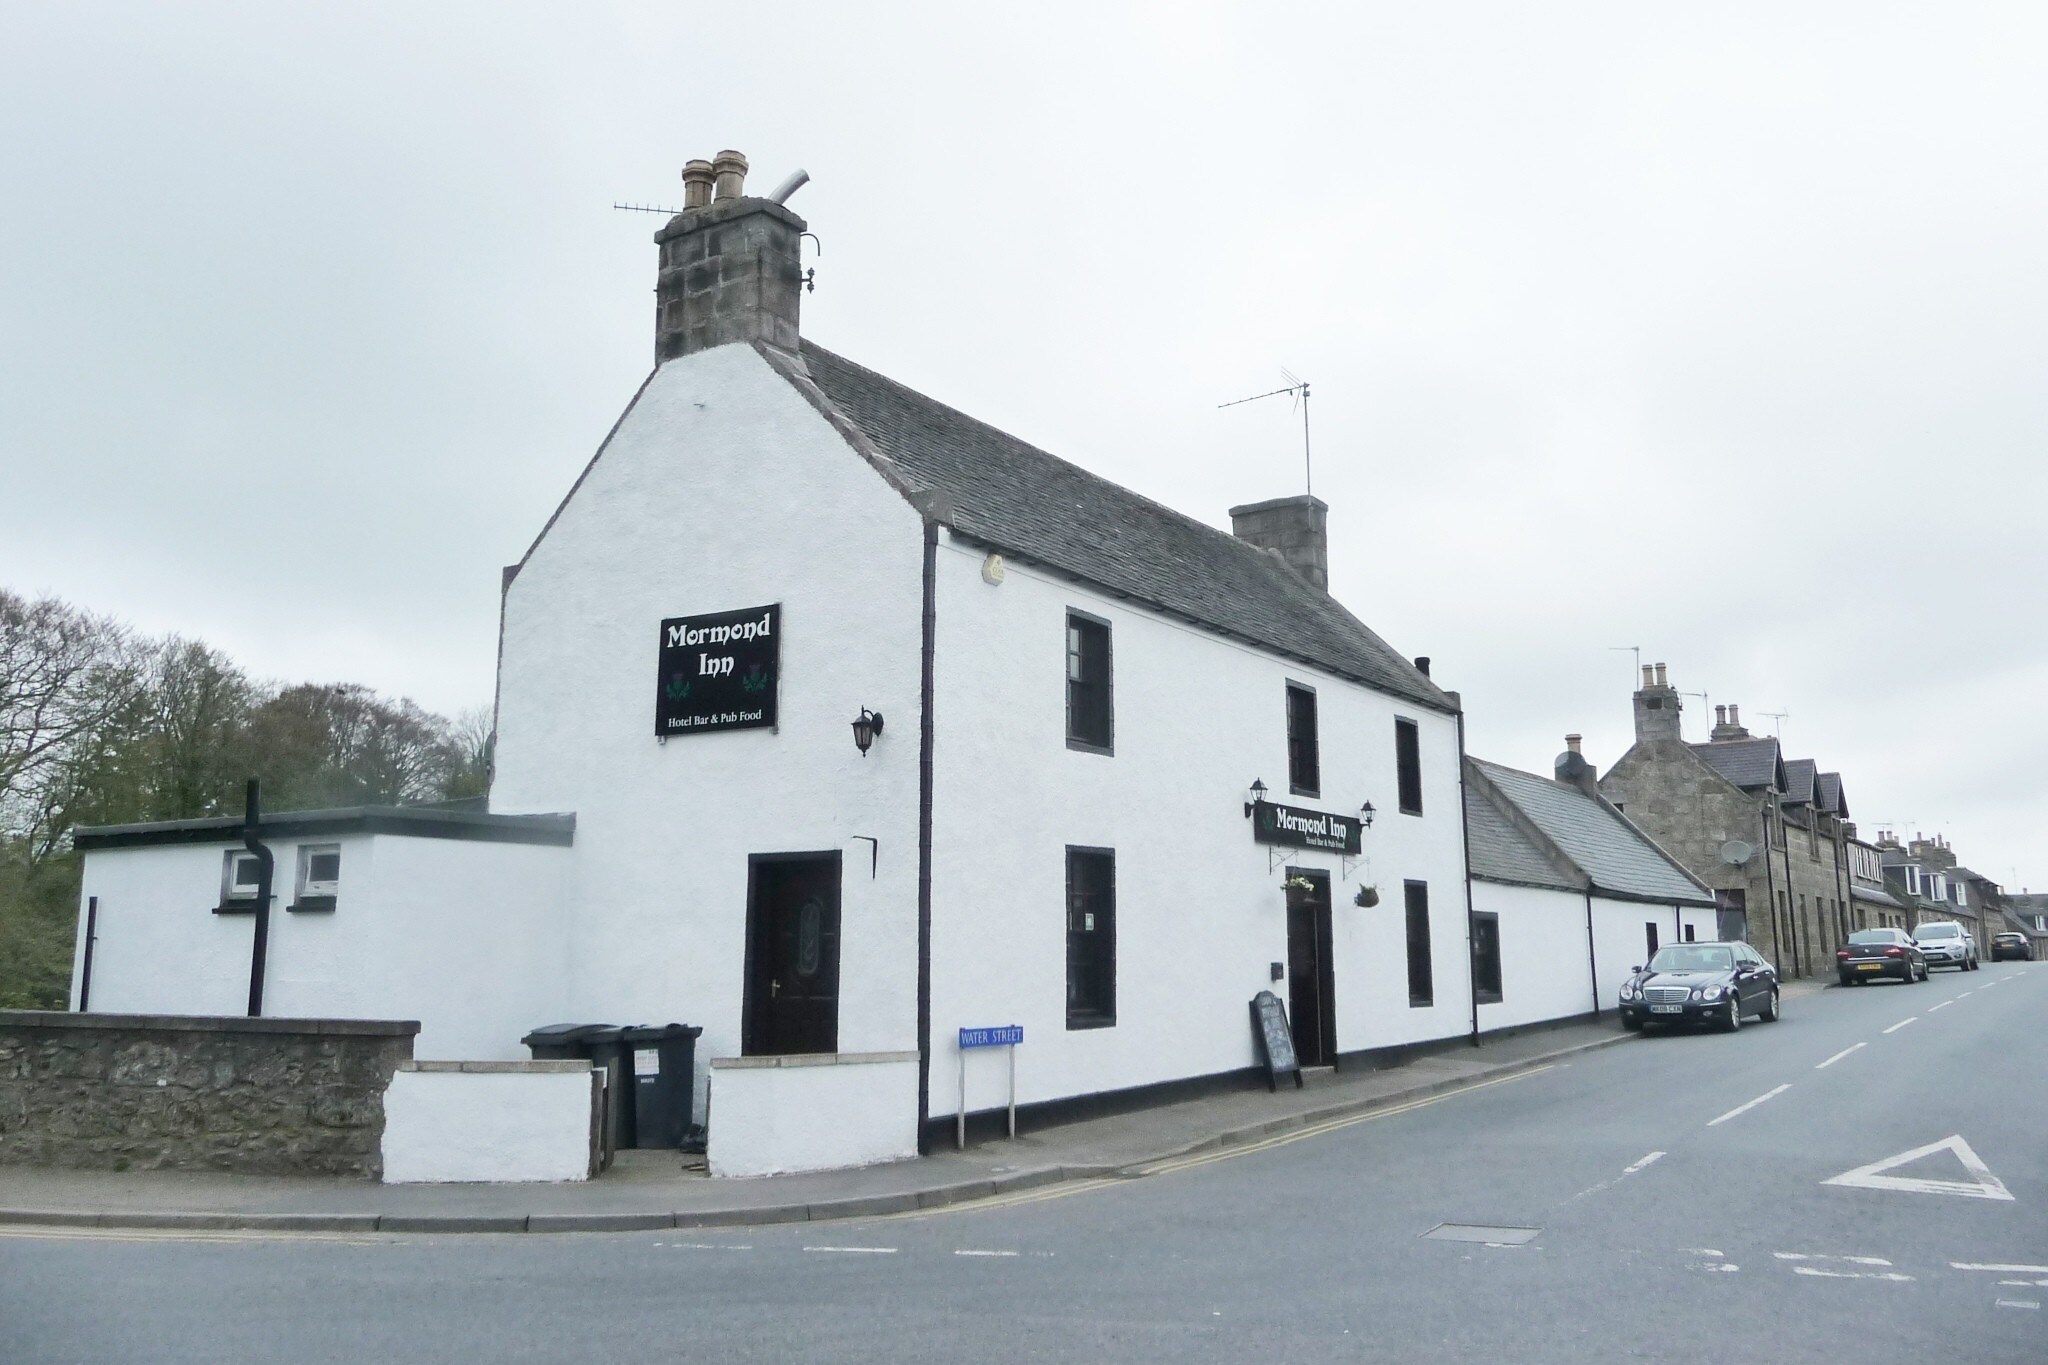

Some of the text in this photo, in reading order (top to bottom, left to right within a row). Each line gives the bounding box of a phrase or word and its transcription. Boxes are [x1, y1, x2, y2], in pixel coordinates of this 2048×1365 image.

[667, 612, 771, 648] Mormond
[698, 652, 735, 678] Inn
[668, 708, 762, 728] Hotel Bar & Pub Food
[1276, 808, 1347, 840] Mormond Inn
[961, 1029, 1021, 1044] WATER STREET
